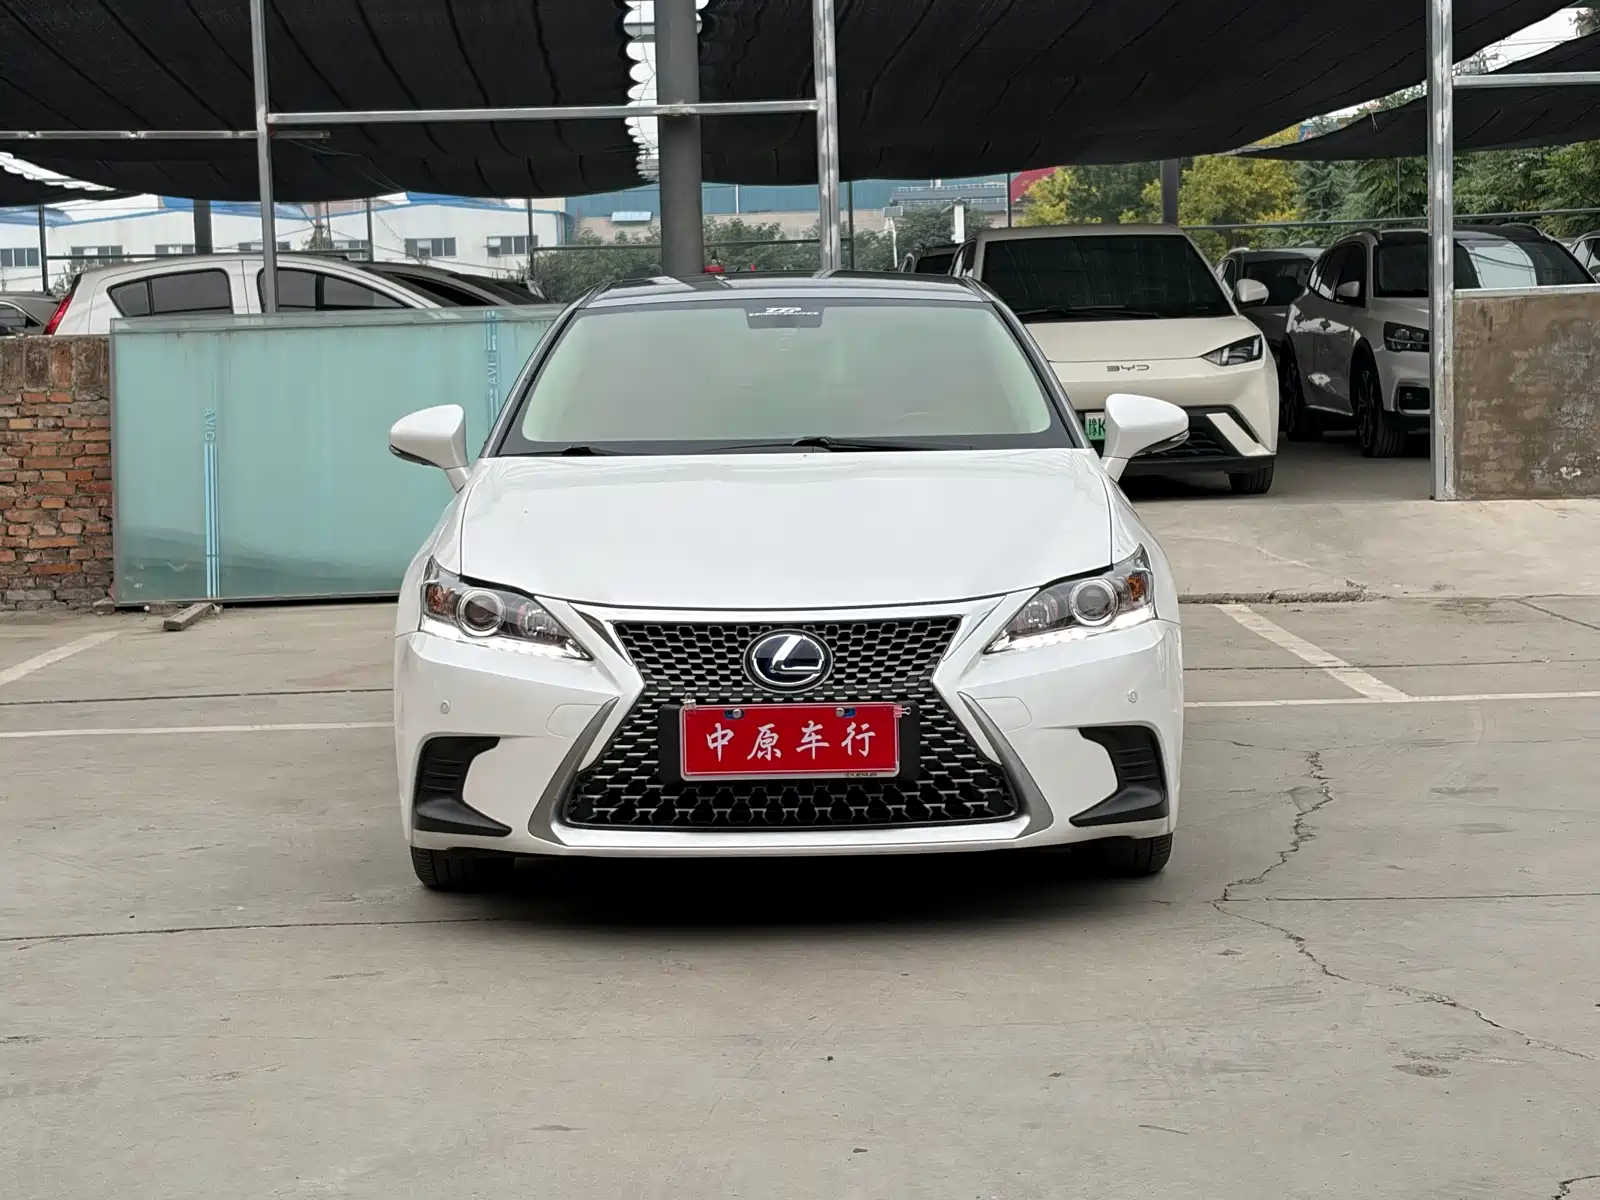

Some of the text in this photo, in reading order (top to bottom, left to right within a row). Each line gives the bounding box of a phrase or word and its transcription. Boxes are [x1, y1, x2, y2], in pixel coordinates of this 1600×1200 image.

[1106, 364, 1150, 372] BYD
[706, 720, 876, 762] 中原车行
